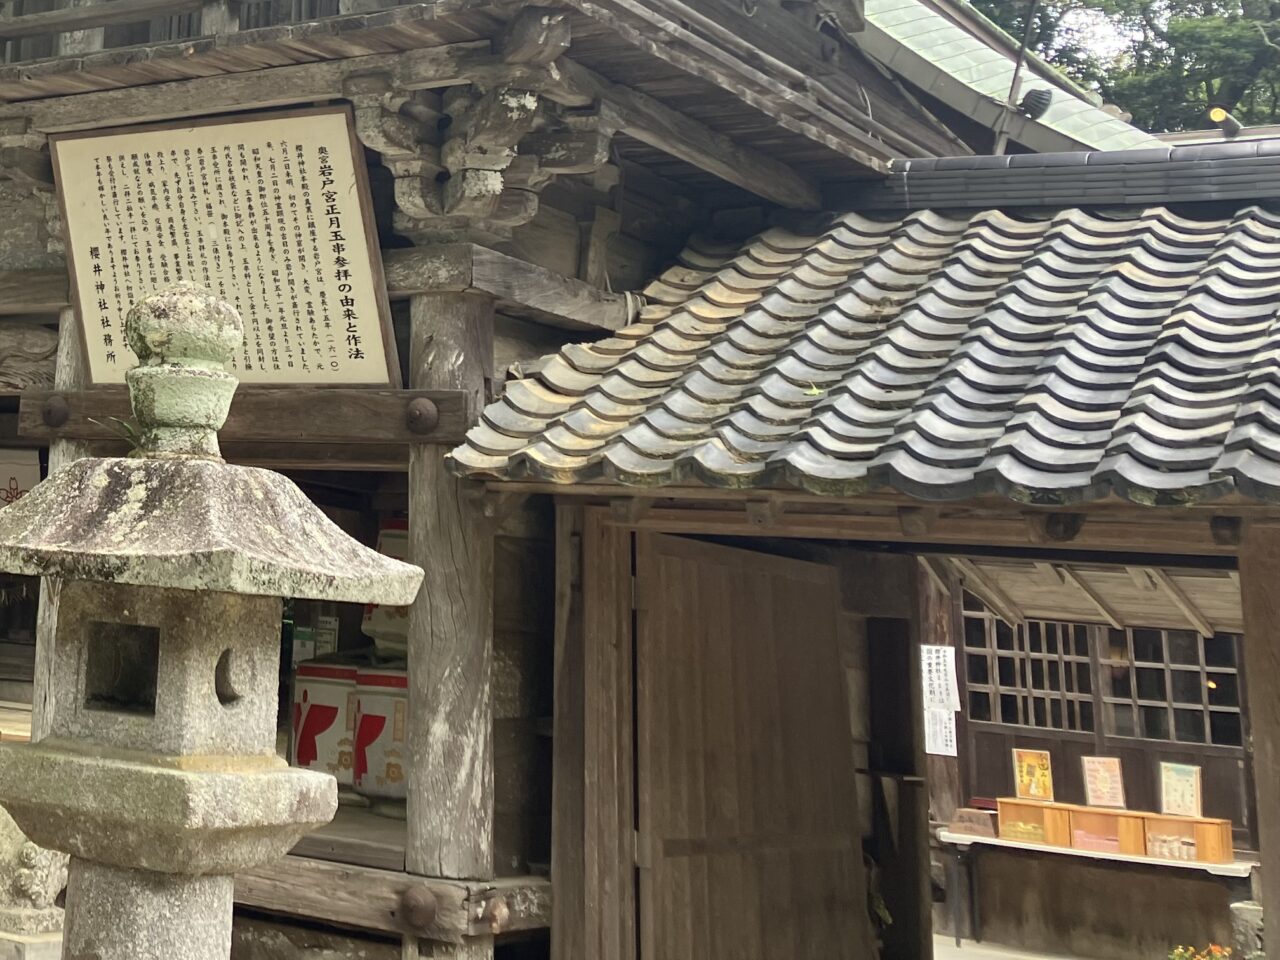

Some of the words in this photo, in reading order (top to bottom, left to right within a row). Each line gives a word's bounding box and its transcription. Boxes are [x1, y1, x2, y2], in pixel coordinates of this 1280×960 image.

[89, 246, 115, 363] 櫻井神社社務所
